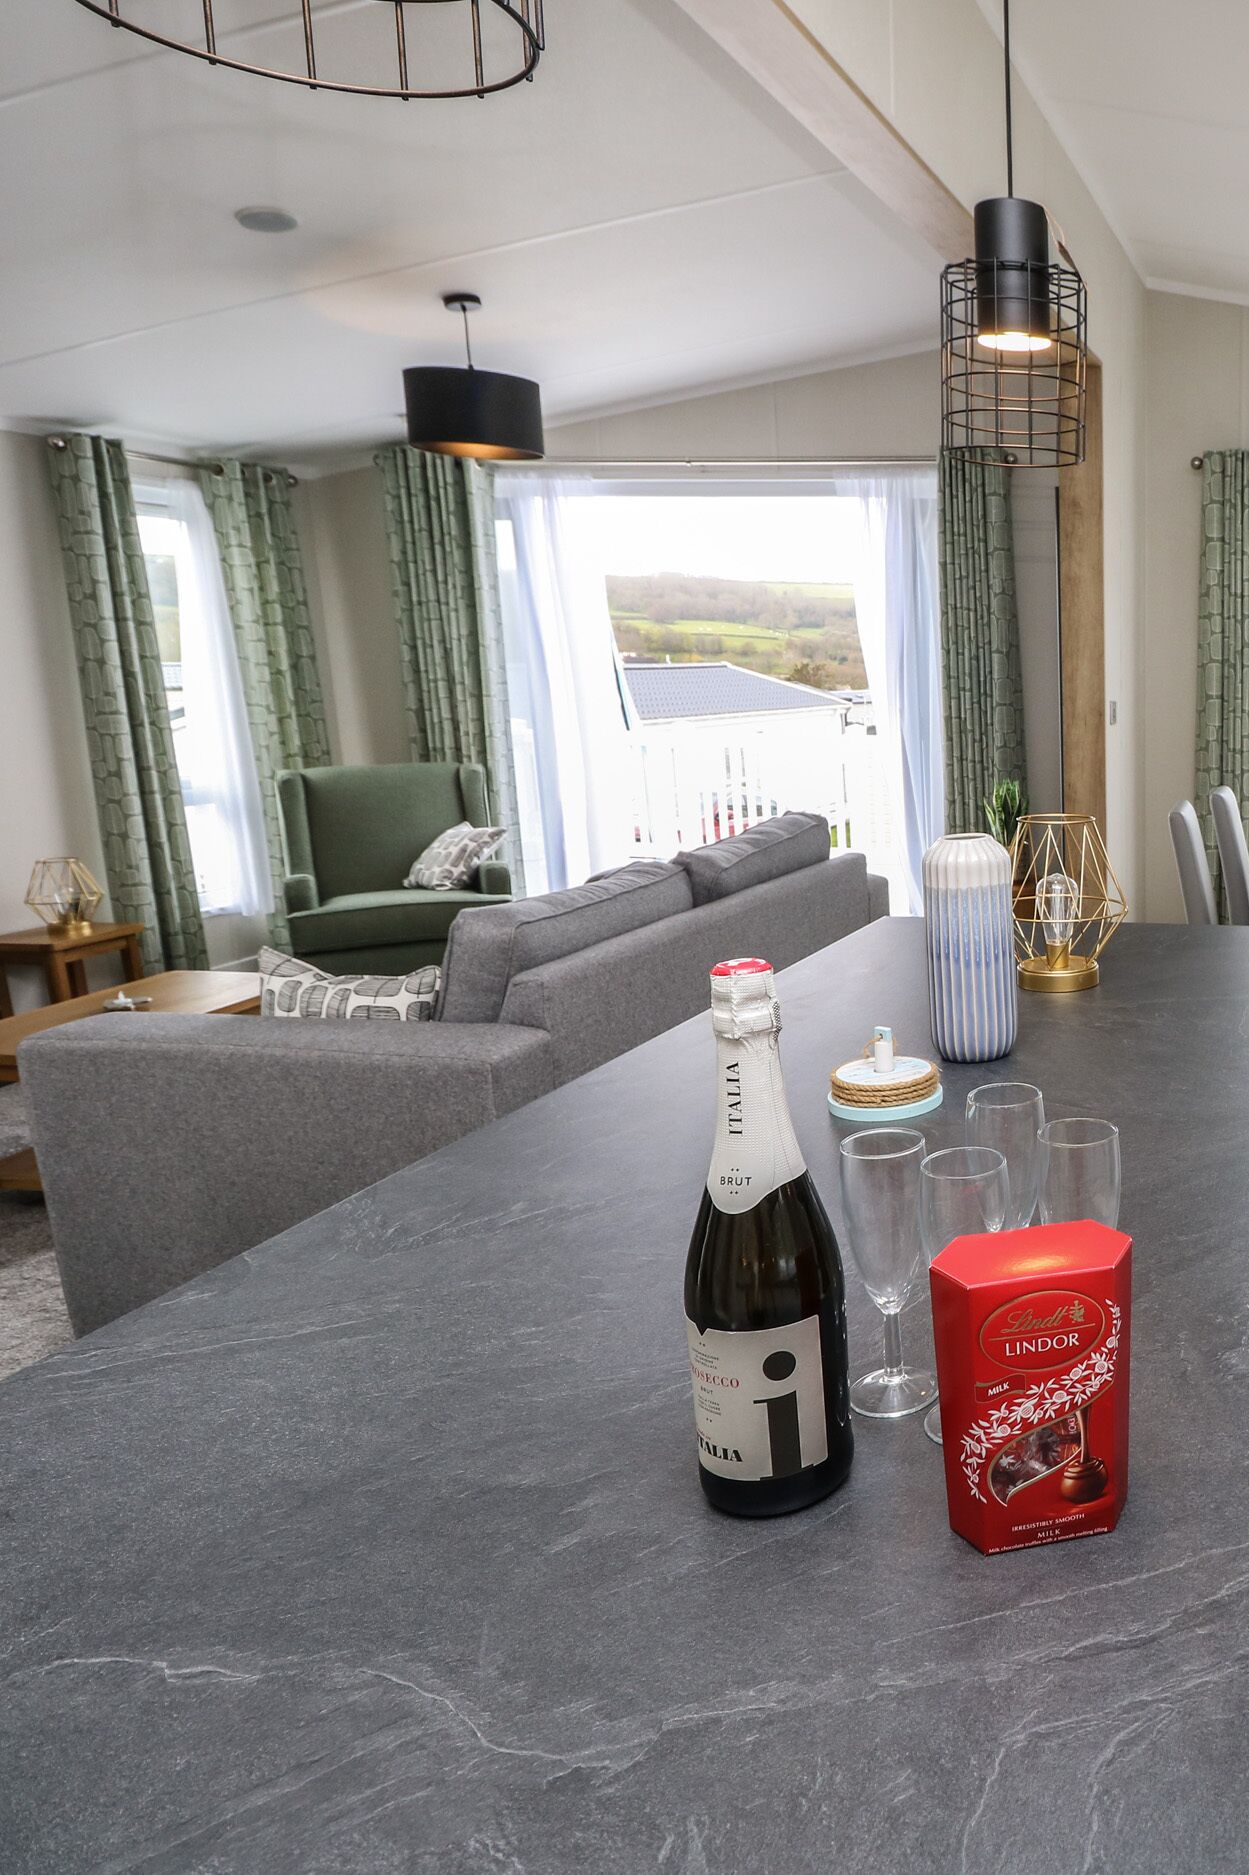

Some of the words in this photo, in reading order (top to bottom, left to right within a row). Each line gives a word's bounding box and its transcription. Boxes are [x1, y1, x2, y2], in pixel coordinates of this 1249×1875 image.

[726, 1061, 743, 1136] ITALIA
[719, 1176, 753, 1187] BRUT
[1001, 1306, 1068, 1333] Lindt
[1005, 1333, 1080, 1356] LINDOR
[690, 1361, 740, 1389] ROSECCO
[987, 1381, 1010, 1397] MILK
[1011, 1519, 1054, 1532] IRRESISTIBLY
[1055, 1513, 1085, 1525] SMOOTH
[1037, 1528, 1061, 1539] MILK
